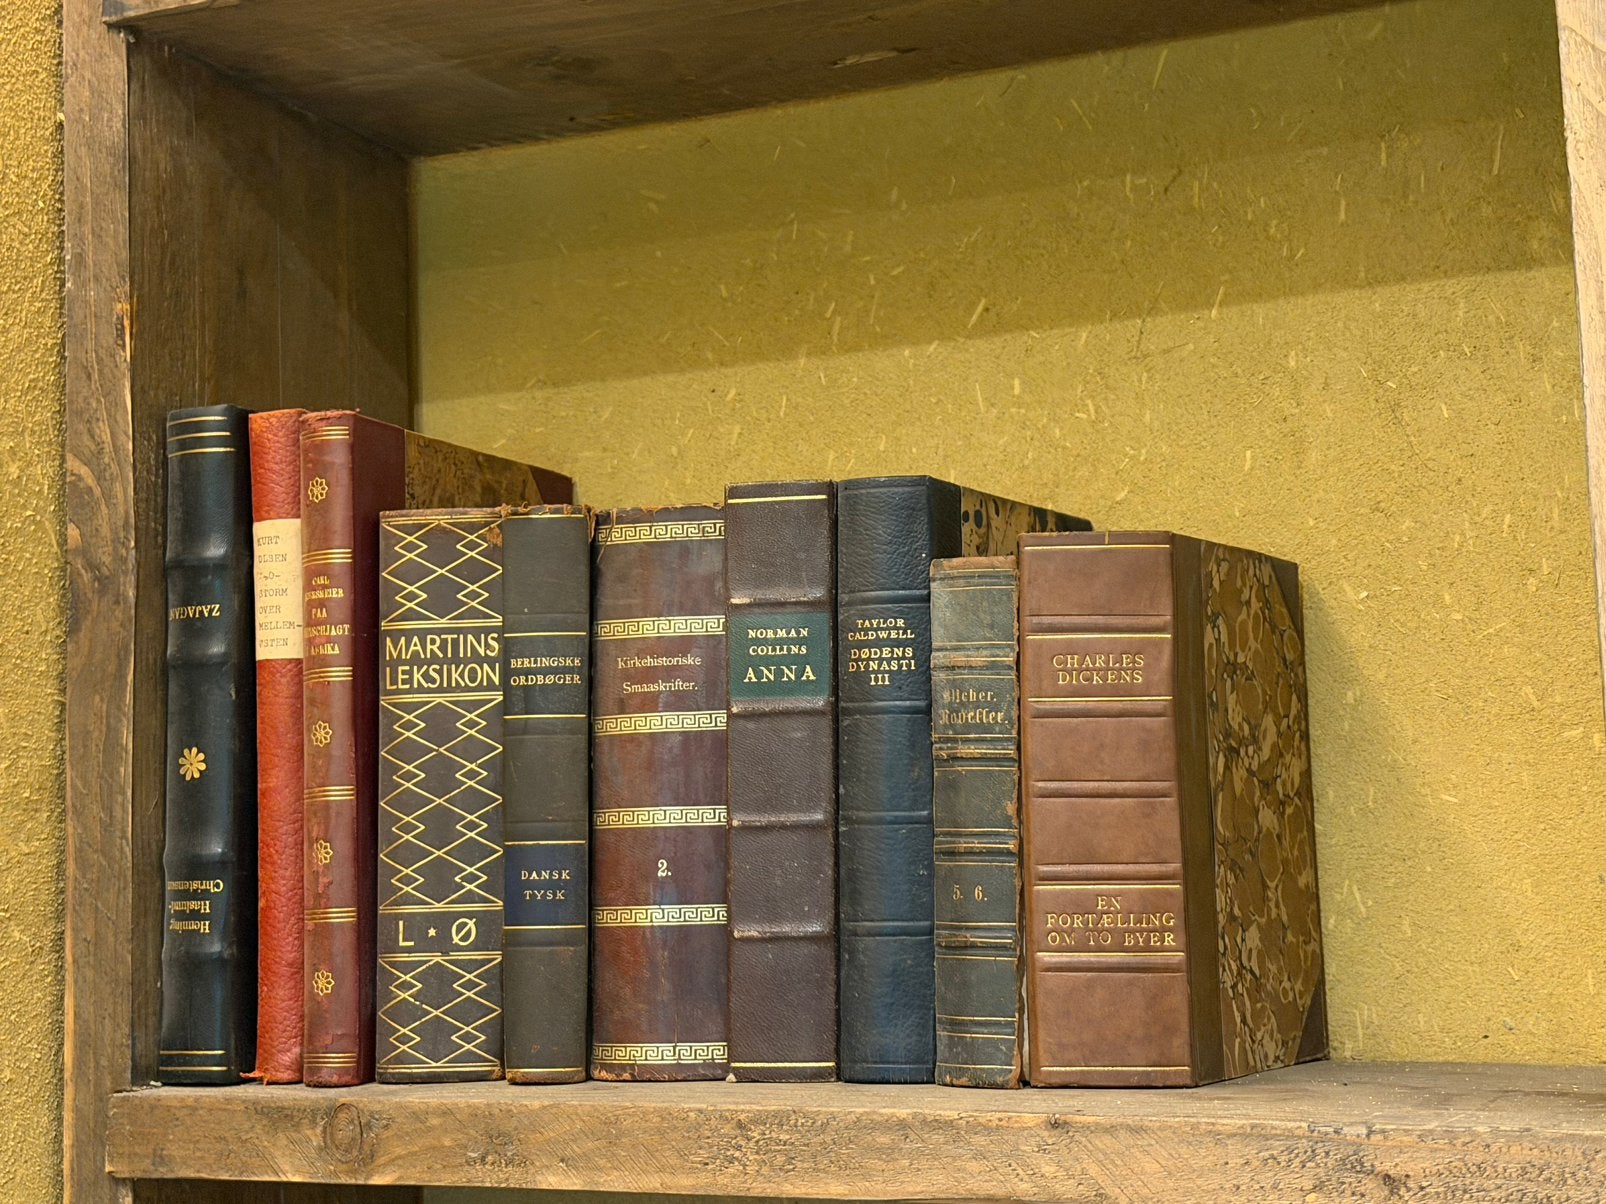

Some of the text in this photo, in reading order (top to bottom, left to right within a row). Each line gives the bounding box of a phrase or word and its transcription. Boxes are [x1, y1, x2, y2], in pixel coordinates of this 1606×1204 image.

[257, 553, 287, 563] OLSEN
[259, 605, 281, 614] OVER
[856, 618, 905, 628] TAYLOR
[747, 628, 808, 639] NORMAN
[848, 630, 915, 640] CALDWELL
[386, 633, 500, 660] MARTINS
[749, 645, 807, 655] COLLINS
[851, 647, 913, 659] DØDENS
[510, 657, 581, 668] BERLINGSKE
[617, 654, 702, 669] Kirkehistoriske
[849, 660, 916, 672] DYNASTI
[1053, 654, 1145, 668] CHARLES
[386, 663, 500, 690] LEKSIKON
[510, 674, 581, 686] ORDBØGER
[743, 665, 816, 682] ANNA
[870, 674, 890, 685] III
[1057, 670, 1143, 684] DICKENS
[623, 678, 698, 694] Smaaskrifter.
[658, 859, 672, 877] 2.
[521, 870, 570, 880] DANSK
[523, 890, 565, 900] TYSK
[975, 885, 988, 901] 6.
[1097, 896, 1122, 910] EN
[1046, 913, 1175, 928] FORTÆLLING
[398, 918, 477, 946] L Ø
[1047, 931, 1176, 946] OM TO BYER
